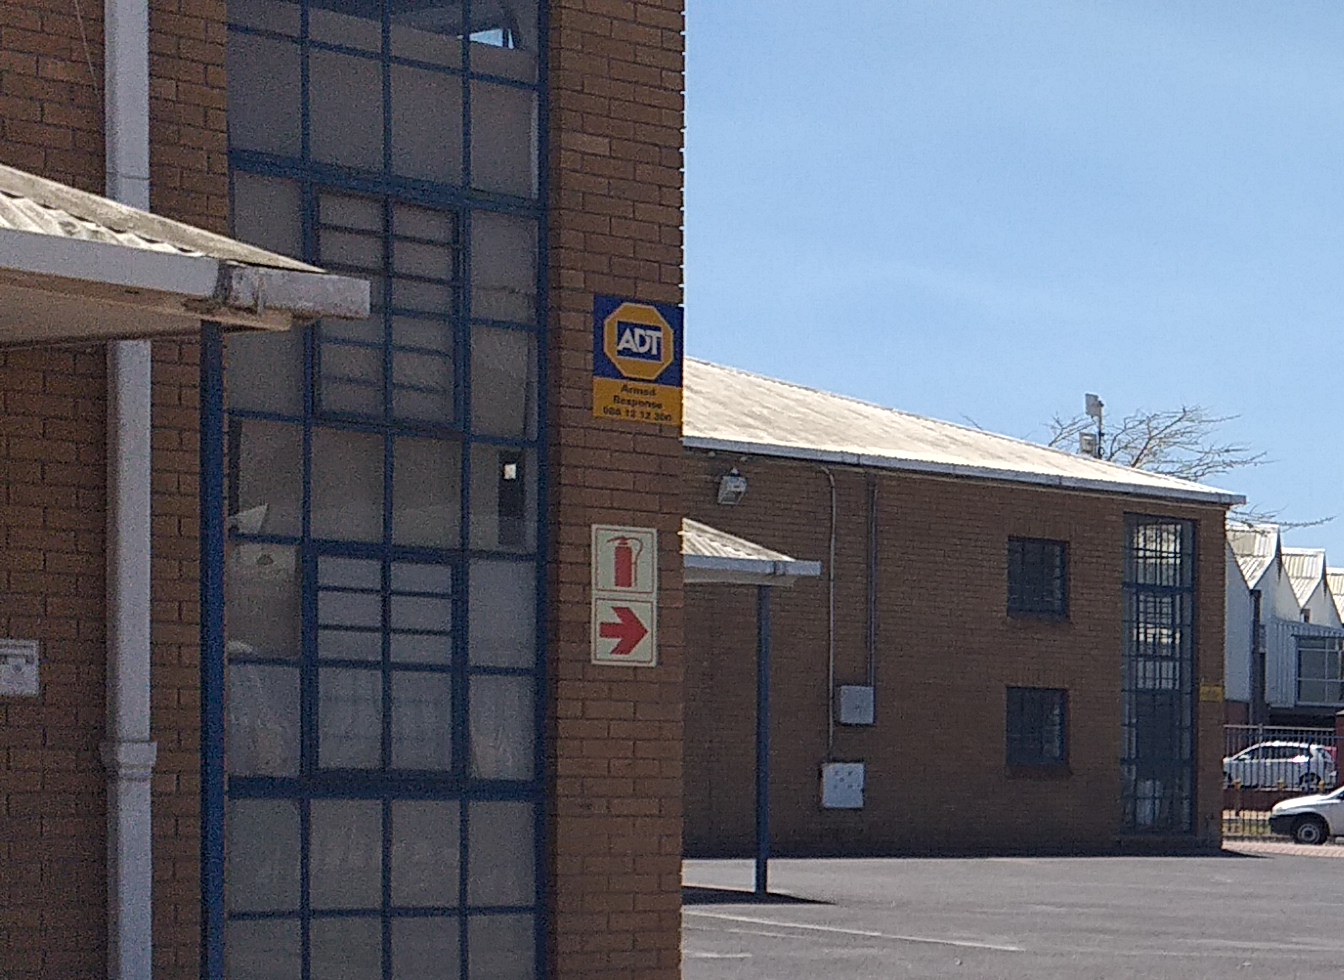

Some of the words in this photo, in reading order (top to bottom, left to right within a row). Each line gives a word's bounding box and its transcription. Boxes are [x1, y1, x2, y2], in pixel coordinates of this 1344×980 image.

[617, 327, 662, 355] ADT
[621, 384, 657, 396] Armed
[613, 395, 663, 410] Response
